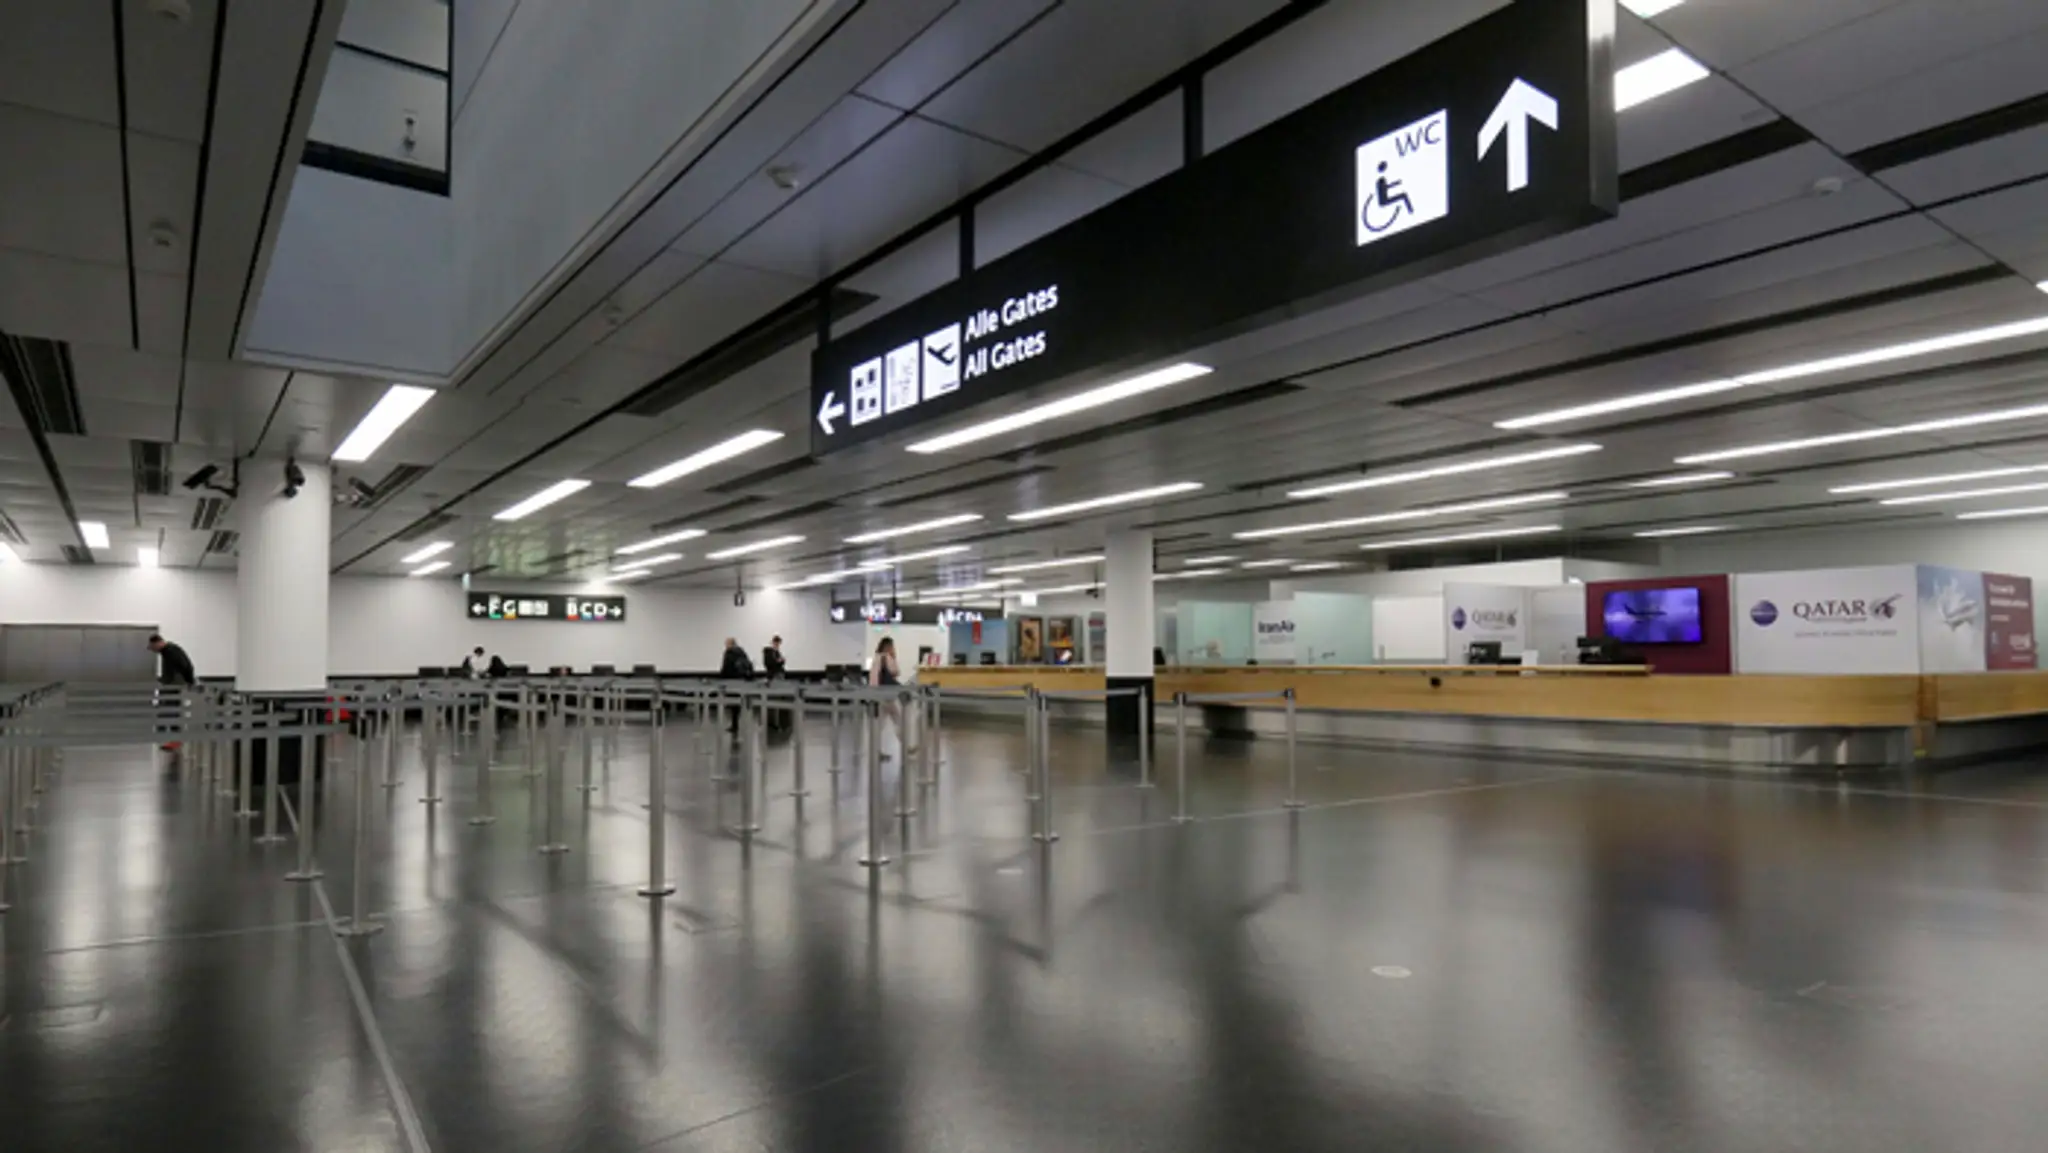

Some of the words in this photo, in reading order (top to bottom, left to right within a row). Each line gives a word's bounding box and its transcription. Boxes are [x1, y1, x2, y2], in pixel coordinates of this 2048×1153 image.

[1395, 119, 1441, 157] WC
[964, 309, 998, 342] Alle
[1002, 284, 1058, 325] Gates
[963, 347, 988, 379] All
[991, 331, 1046, 369] Gates
[1793, 600, 1867, 620] QATAR
